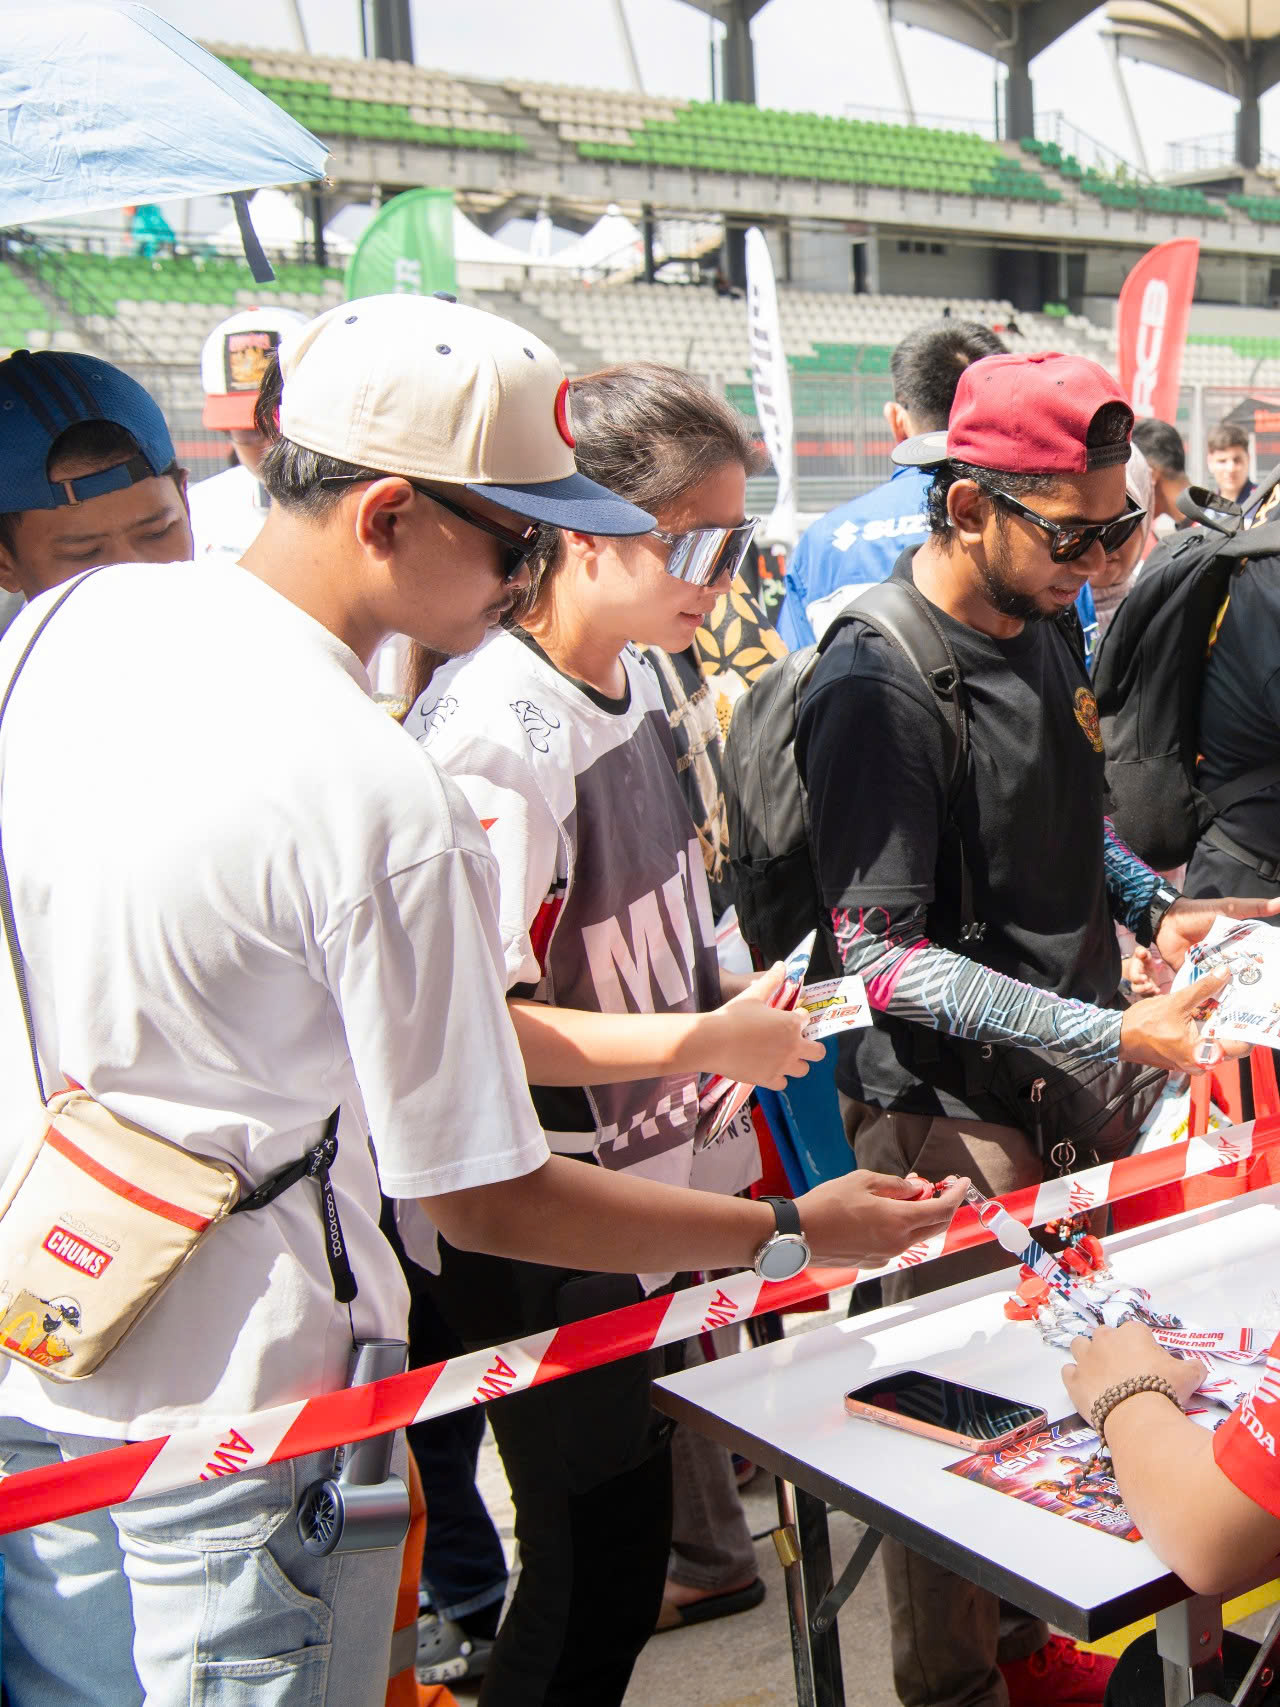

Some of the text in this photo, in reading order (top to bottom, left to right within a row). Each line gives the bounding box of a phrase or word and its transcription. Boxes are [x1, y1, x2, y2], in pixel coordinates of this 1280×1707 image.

[861, 514, 932, 541] SUZ
[47, 1231, 105, 1275] CHUMS
[1169, 1337, 1216, 1348] Vietnam
[1188, 1331, 1225, 1341] Racing
[991, 1450, 1047, 1480] ASIA
